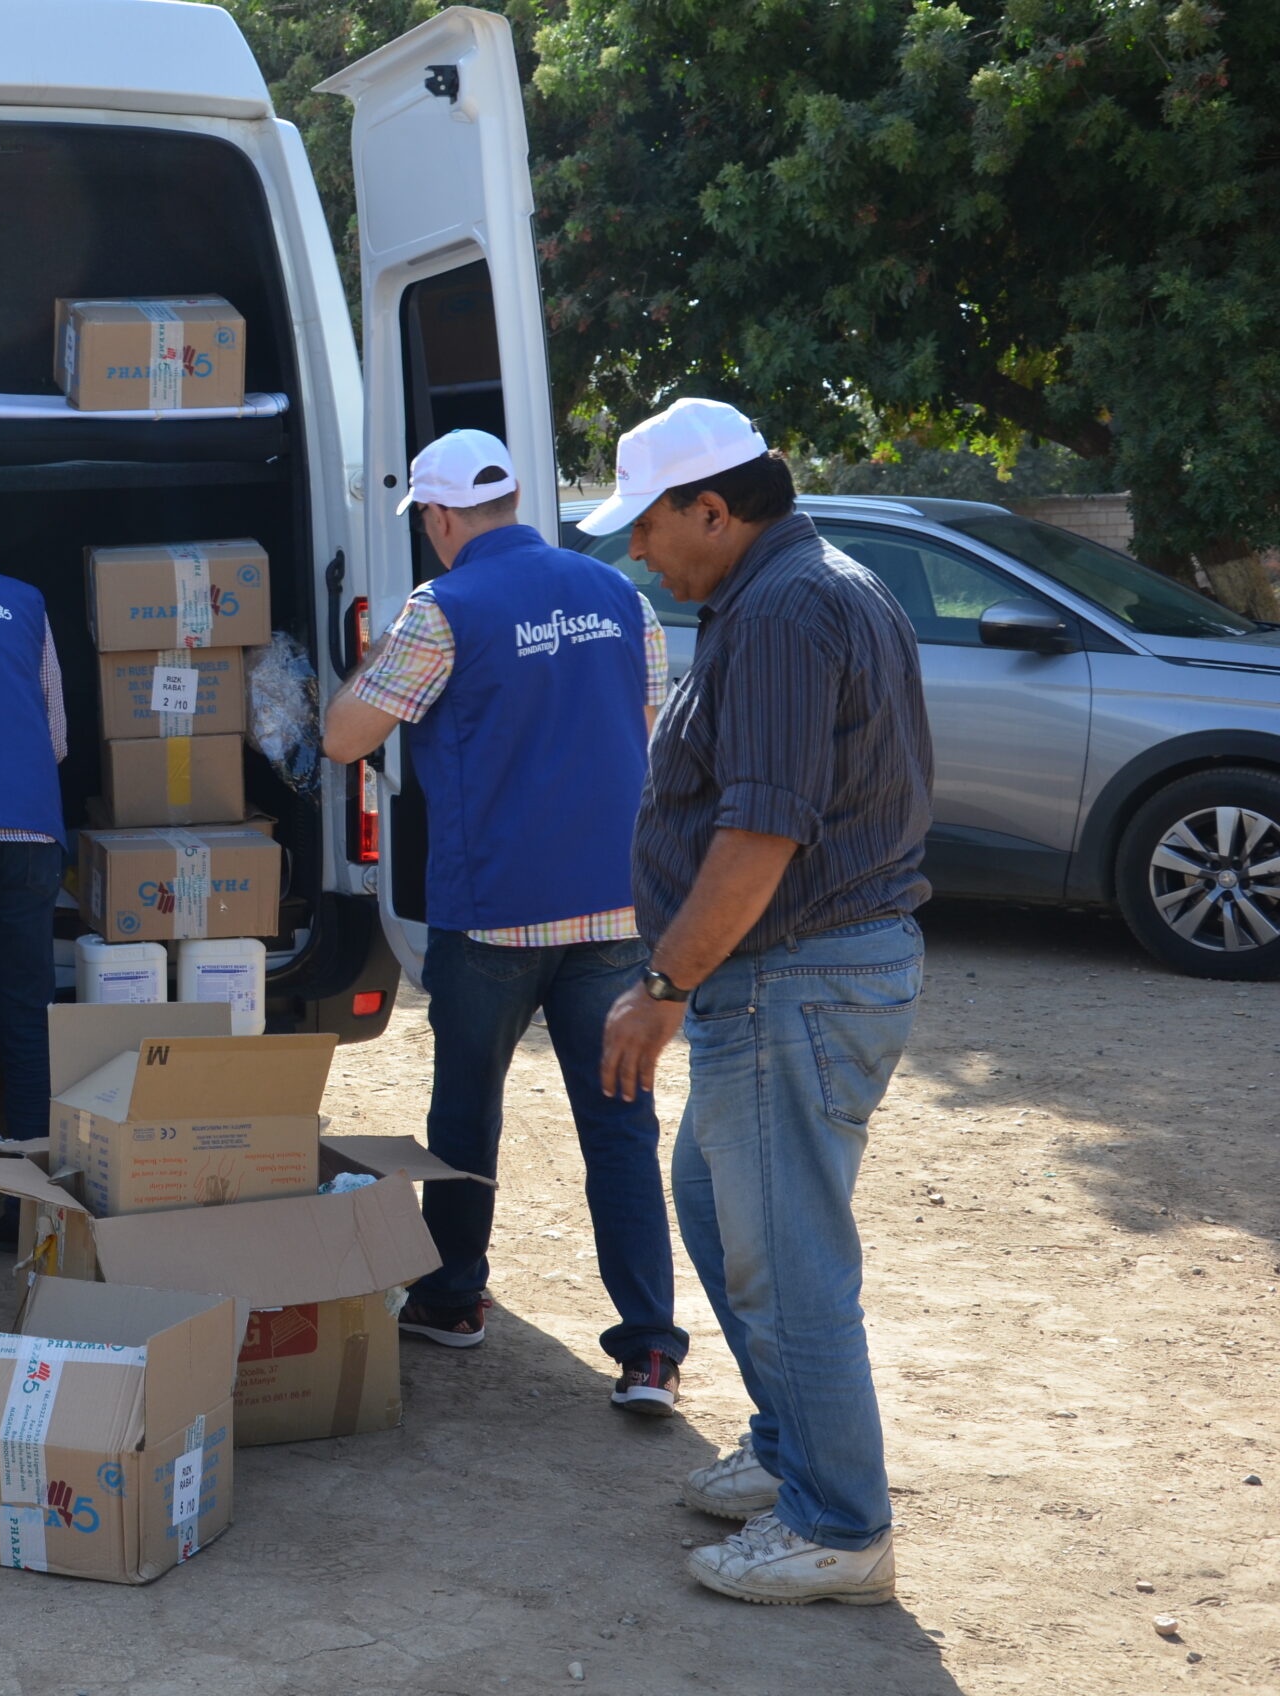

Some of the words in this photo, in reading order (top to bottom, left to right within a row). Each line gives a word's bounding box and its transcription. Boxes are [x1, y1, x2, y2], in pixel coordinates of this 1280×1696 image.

[194, 352, 214, 378] 5
[220, 591, 241, 617] 5
[515, 608, 602, 656] Noufissa
[517, 642, 555, 657] FONDATION
[162, 683, 187, 692] RABAT
[163, 697, 169, 707] 2
[138, 881, 160, 907] 5
[4, 1406, 16, 1437] MAGASIN
[179, 1475, 195, 1490] RABAT
[71, 1495, 101, 1534] 5
[179, 1501, 185, 1515] 5
